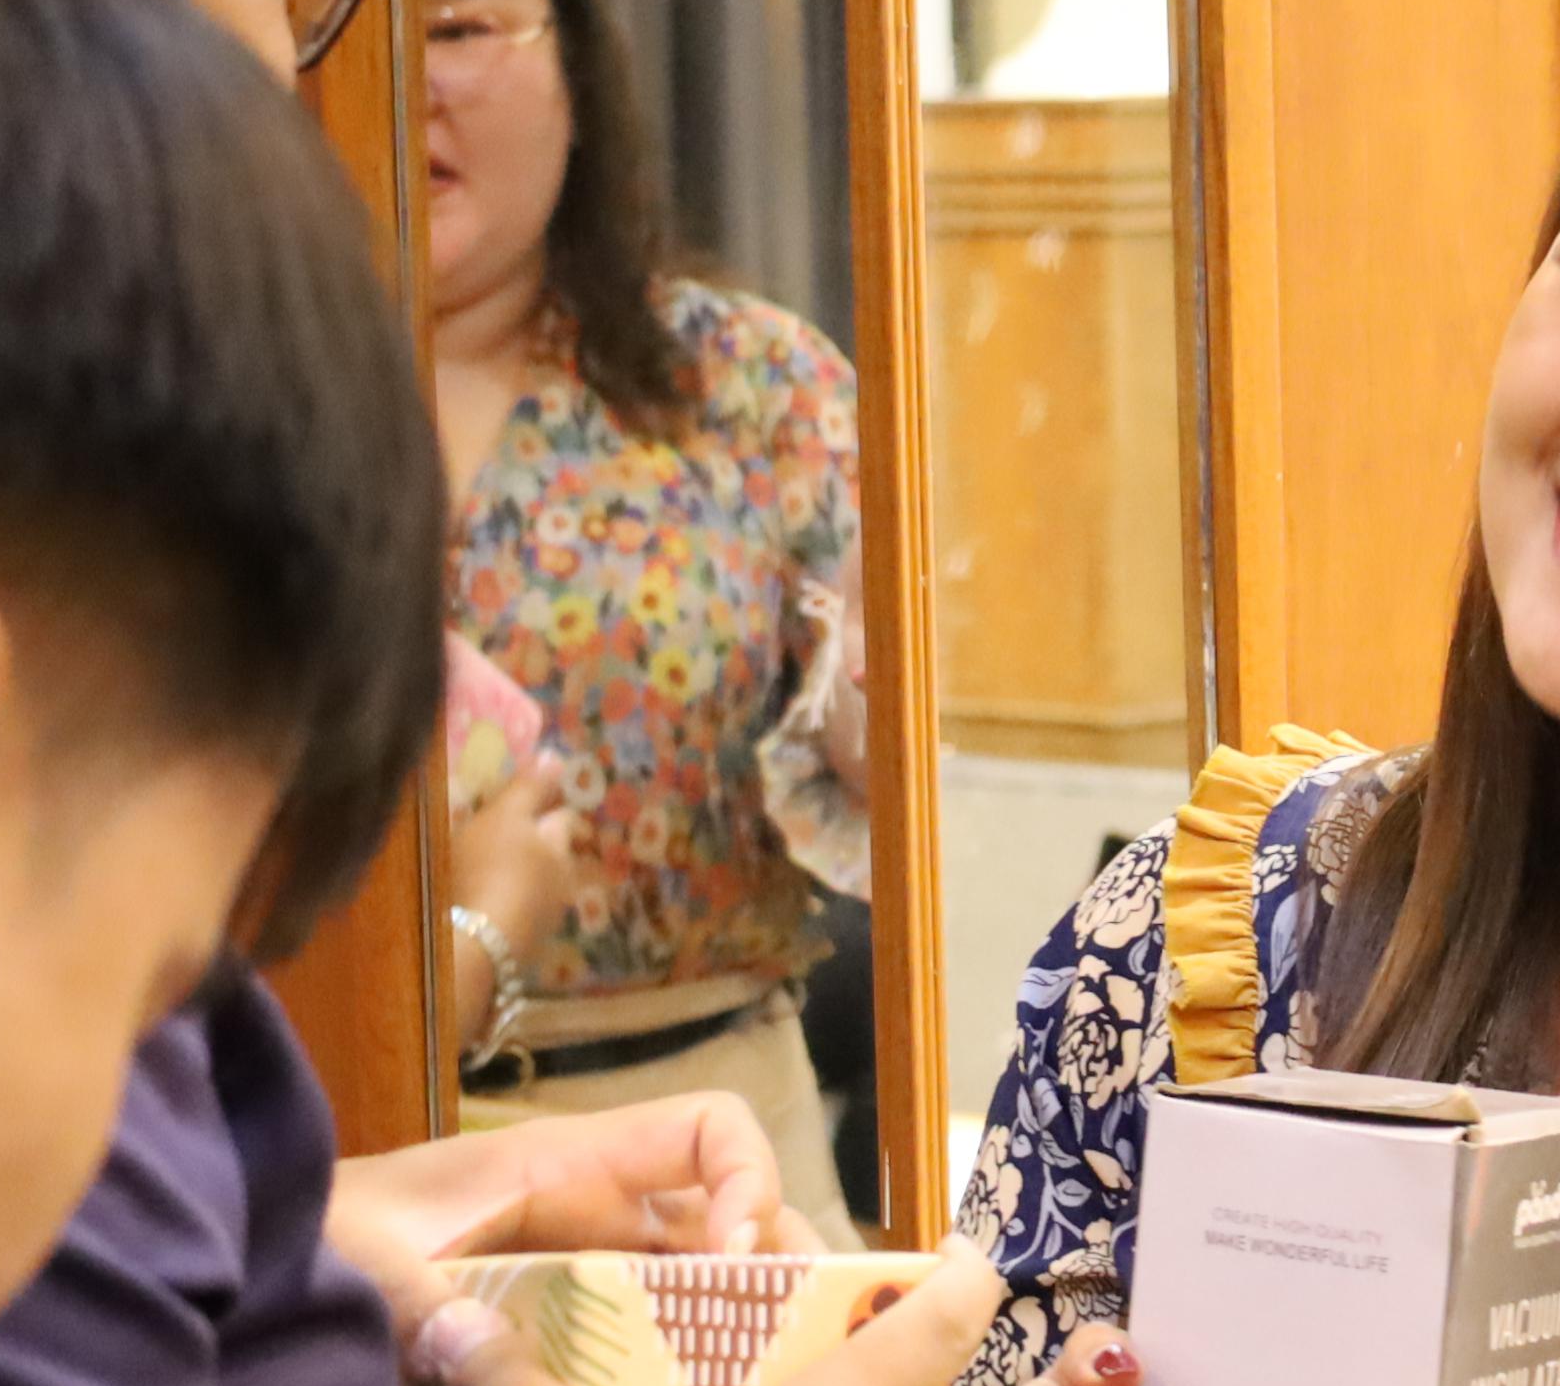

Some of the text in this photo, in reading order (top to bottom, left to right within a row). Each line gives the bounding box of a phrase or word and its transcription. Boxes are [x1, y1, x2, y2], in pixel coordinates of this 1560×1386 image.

[1204, 1229, 1390, 1274] MAKE WONDERFUL LIFE
